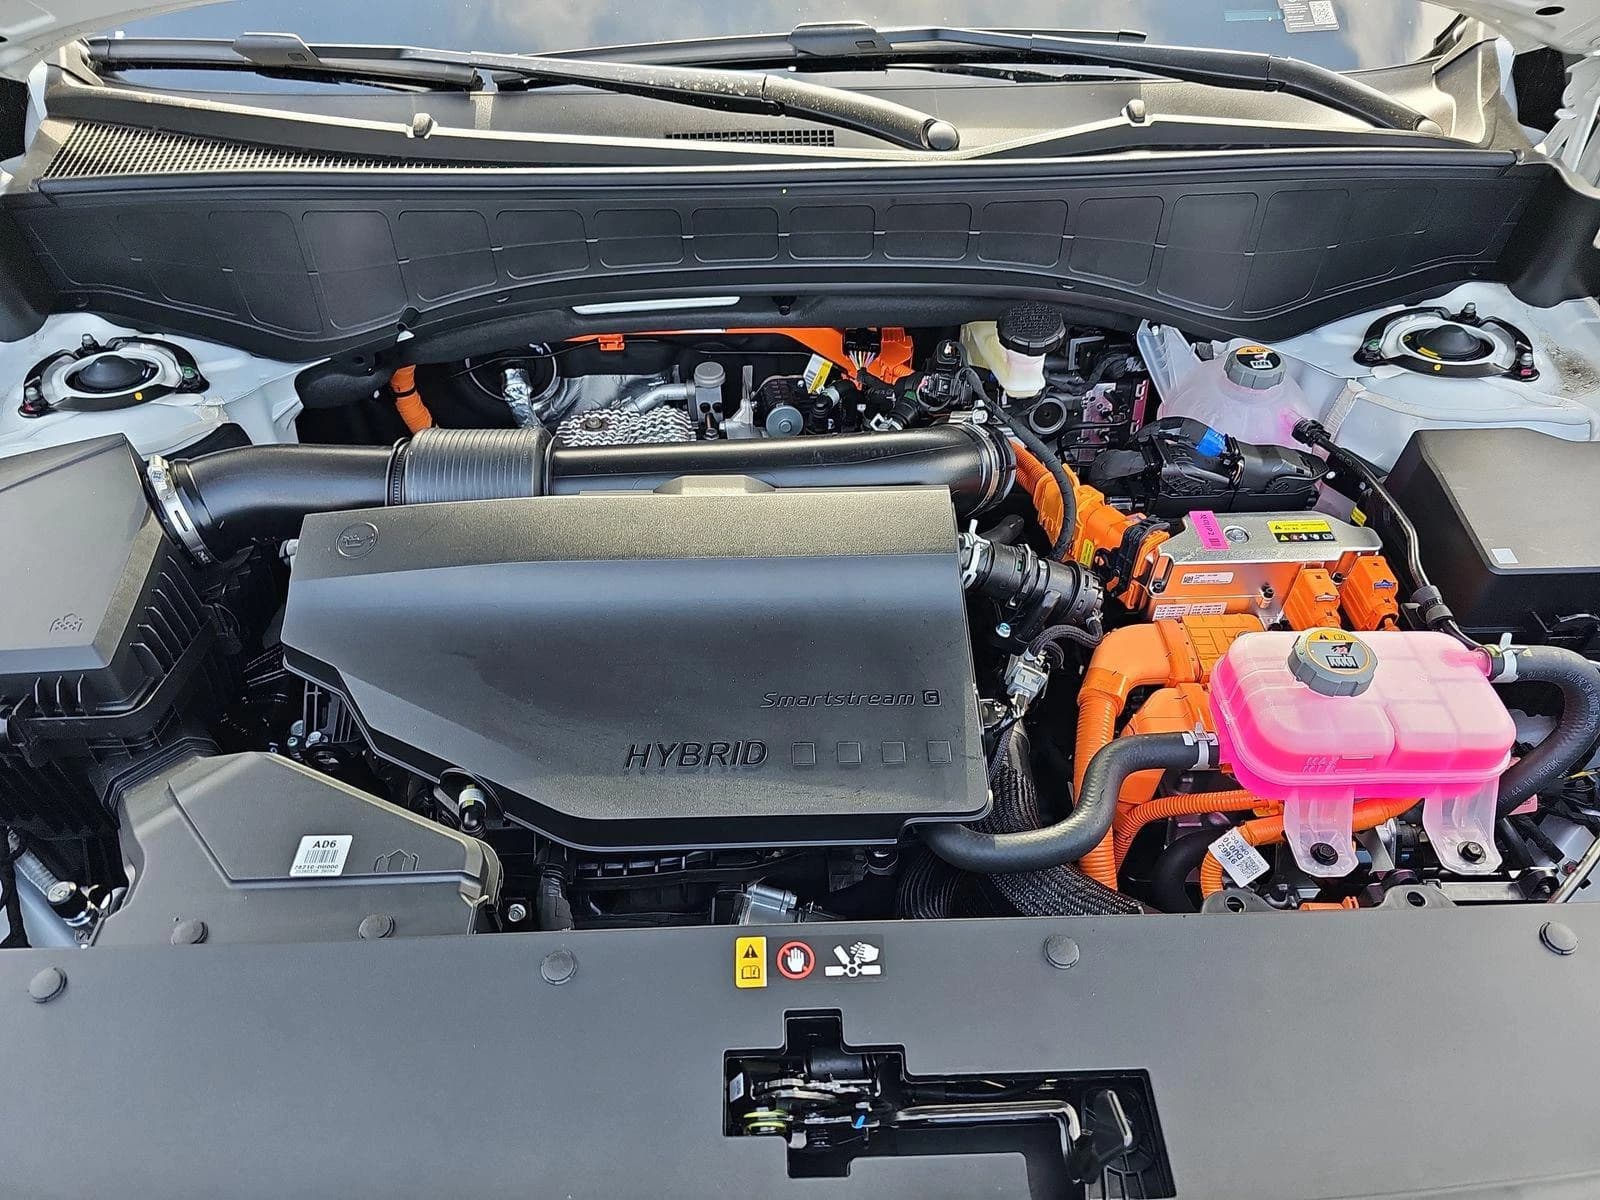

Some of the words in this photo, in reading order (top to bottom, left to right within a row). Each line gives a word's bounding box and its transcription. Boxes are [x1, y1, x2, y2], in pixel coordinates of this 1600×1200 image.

[760, 692, 915, 708] Smartstream
[922, 689, 942, 707] G
[624, 741, 768, 769] HYBRID
[312, 840, 337, 849] AD6
[1217, 843, 1237, 865] 91662
